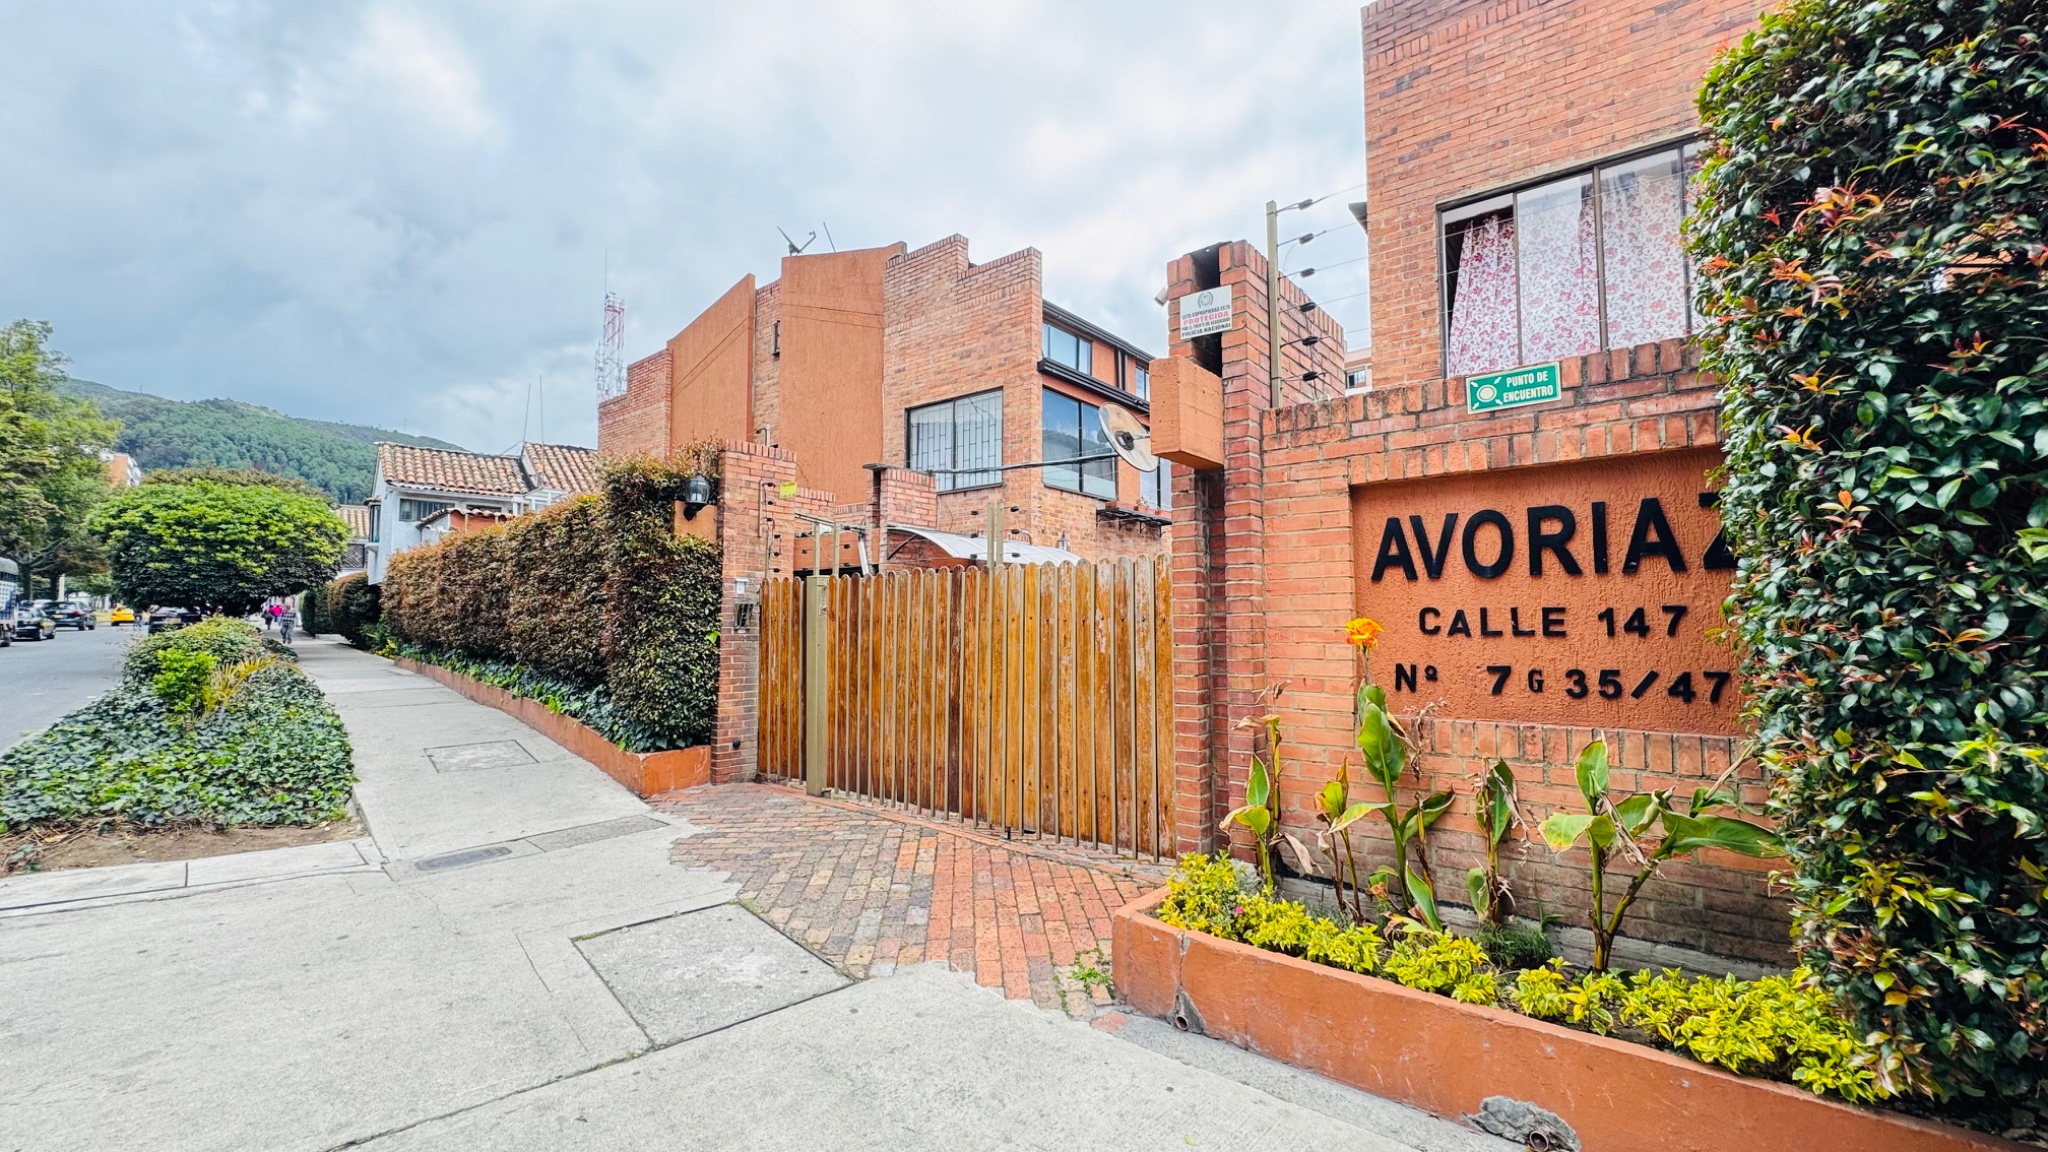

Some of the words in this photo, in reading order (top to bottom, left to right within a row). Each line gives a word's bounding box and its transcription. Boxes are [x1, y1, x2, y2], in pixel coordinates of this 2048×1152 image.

[1183, 311, 1229, 326] PROTEGIDA
[1204, 322, 1231, 332] NACIONAL
[1506, 373, 1535, 388] PUNTO
[1536, 370, 1549, 382] DE
[1503, 384, 1554, 403] ENCUENTRO
[1419, 606, 1568, 637] CALLE
[1598, 604, 1688, 638] 147
